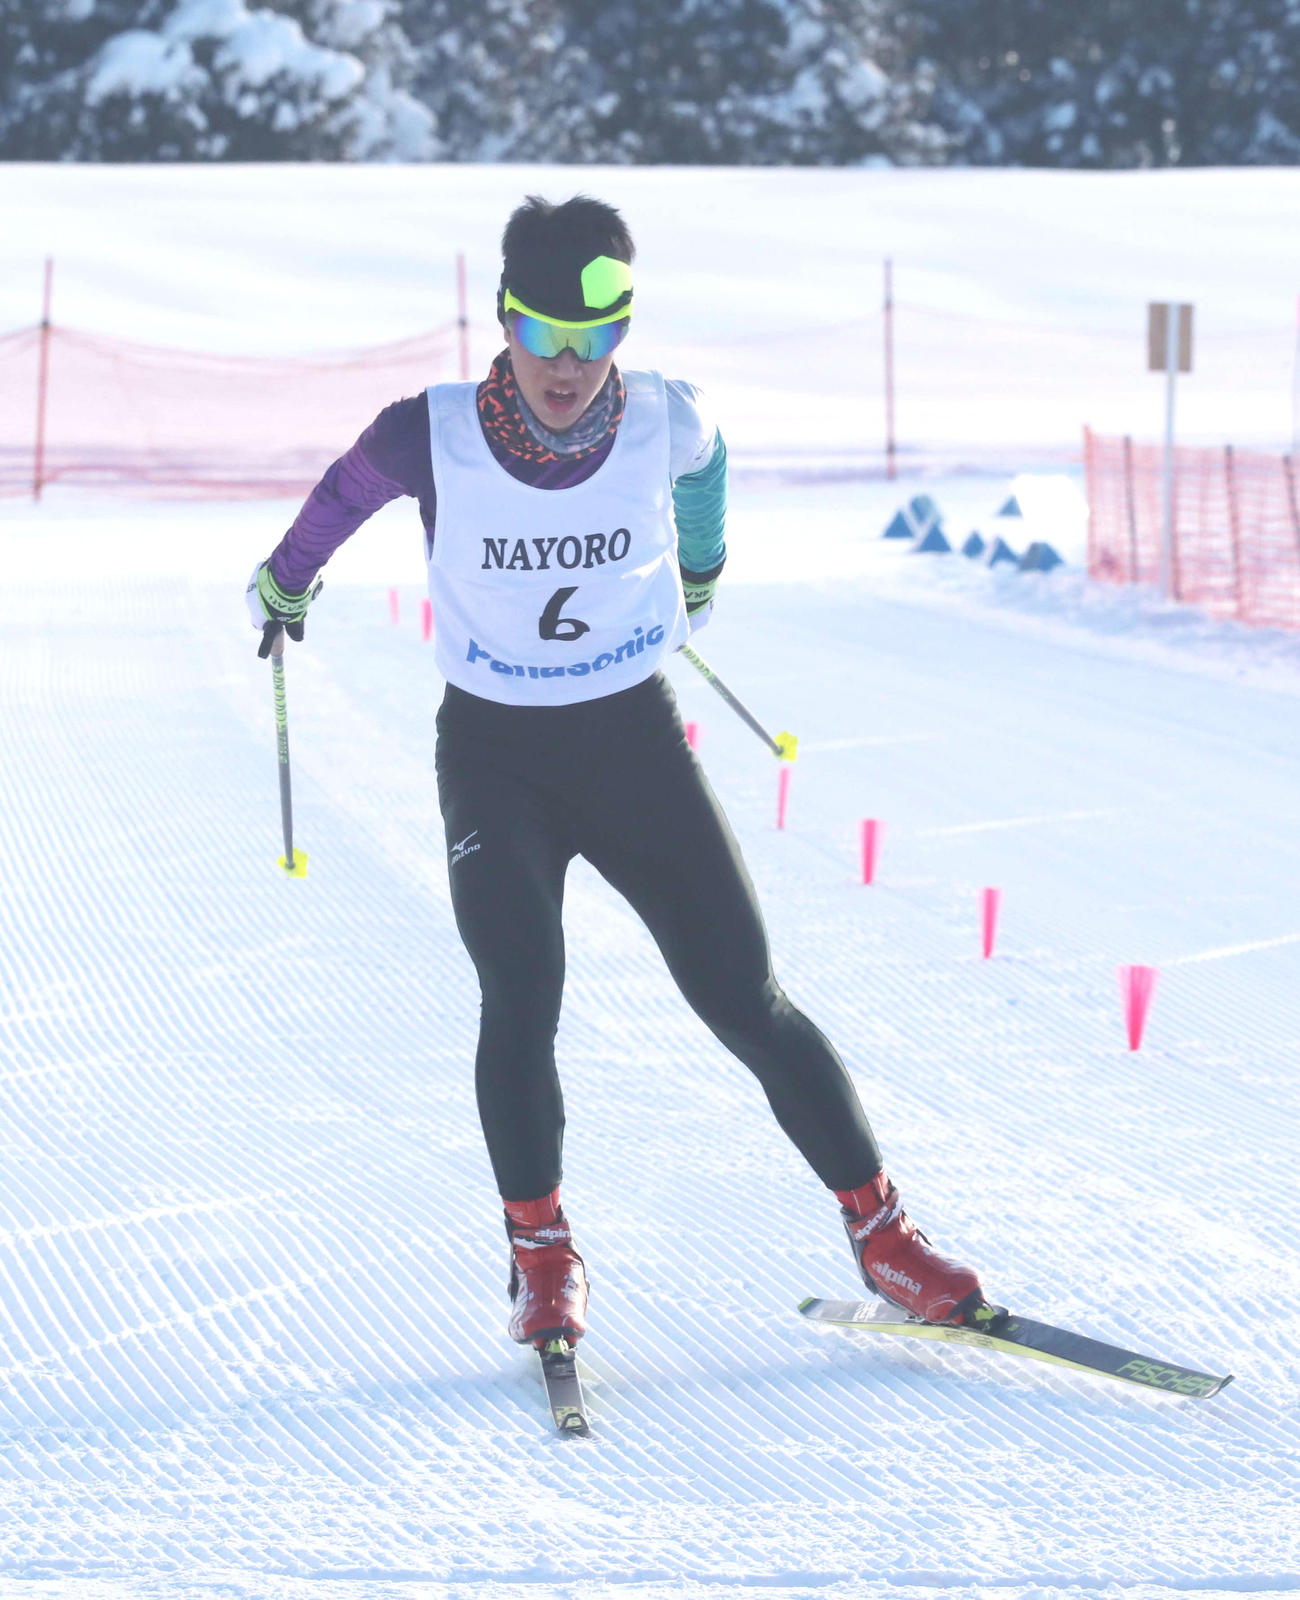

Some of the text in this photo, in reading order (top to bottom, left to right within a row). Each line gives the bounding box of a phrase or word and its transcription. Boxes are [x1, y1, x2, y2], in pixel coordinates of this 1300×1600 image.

[482, 527, 631, 571] NAYORO
[538, 586, 591, 641] 6
[855, 1206, 889, 1241] alpina
[871, 1260, 924, 1296] alpina
[1116, 1359, 1220, 1397] FISCHER
